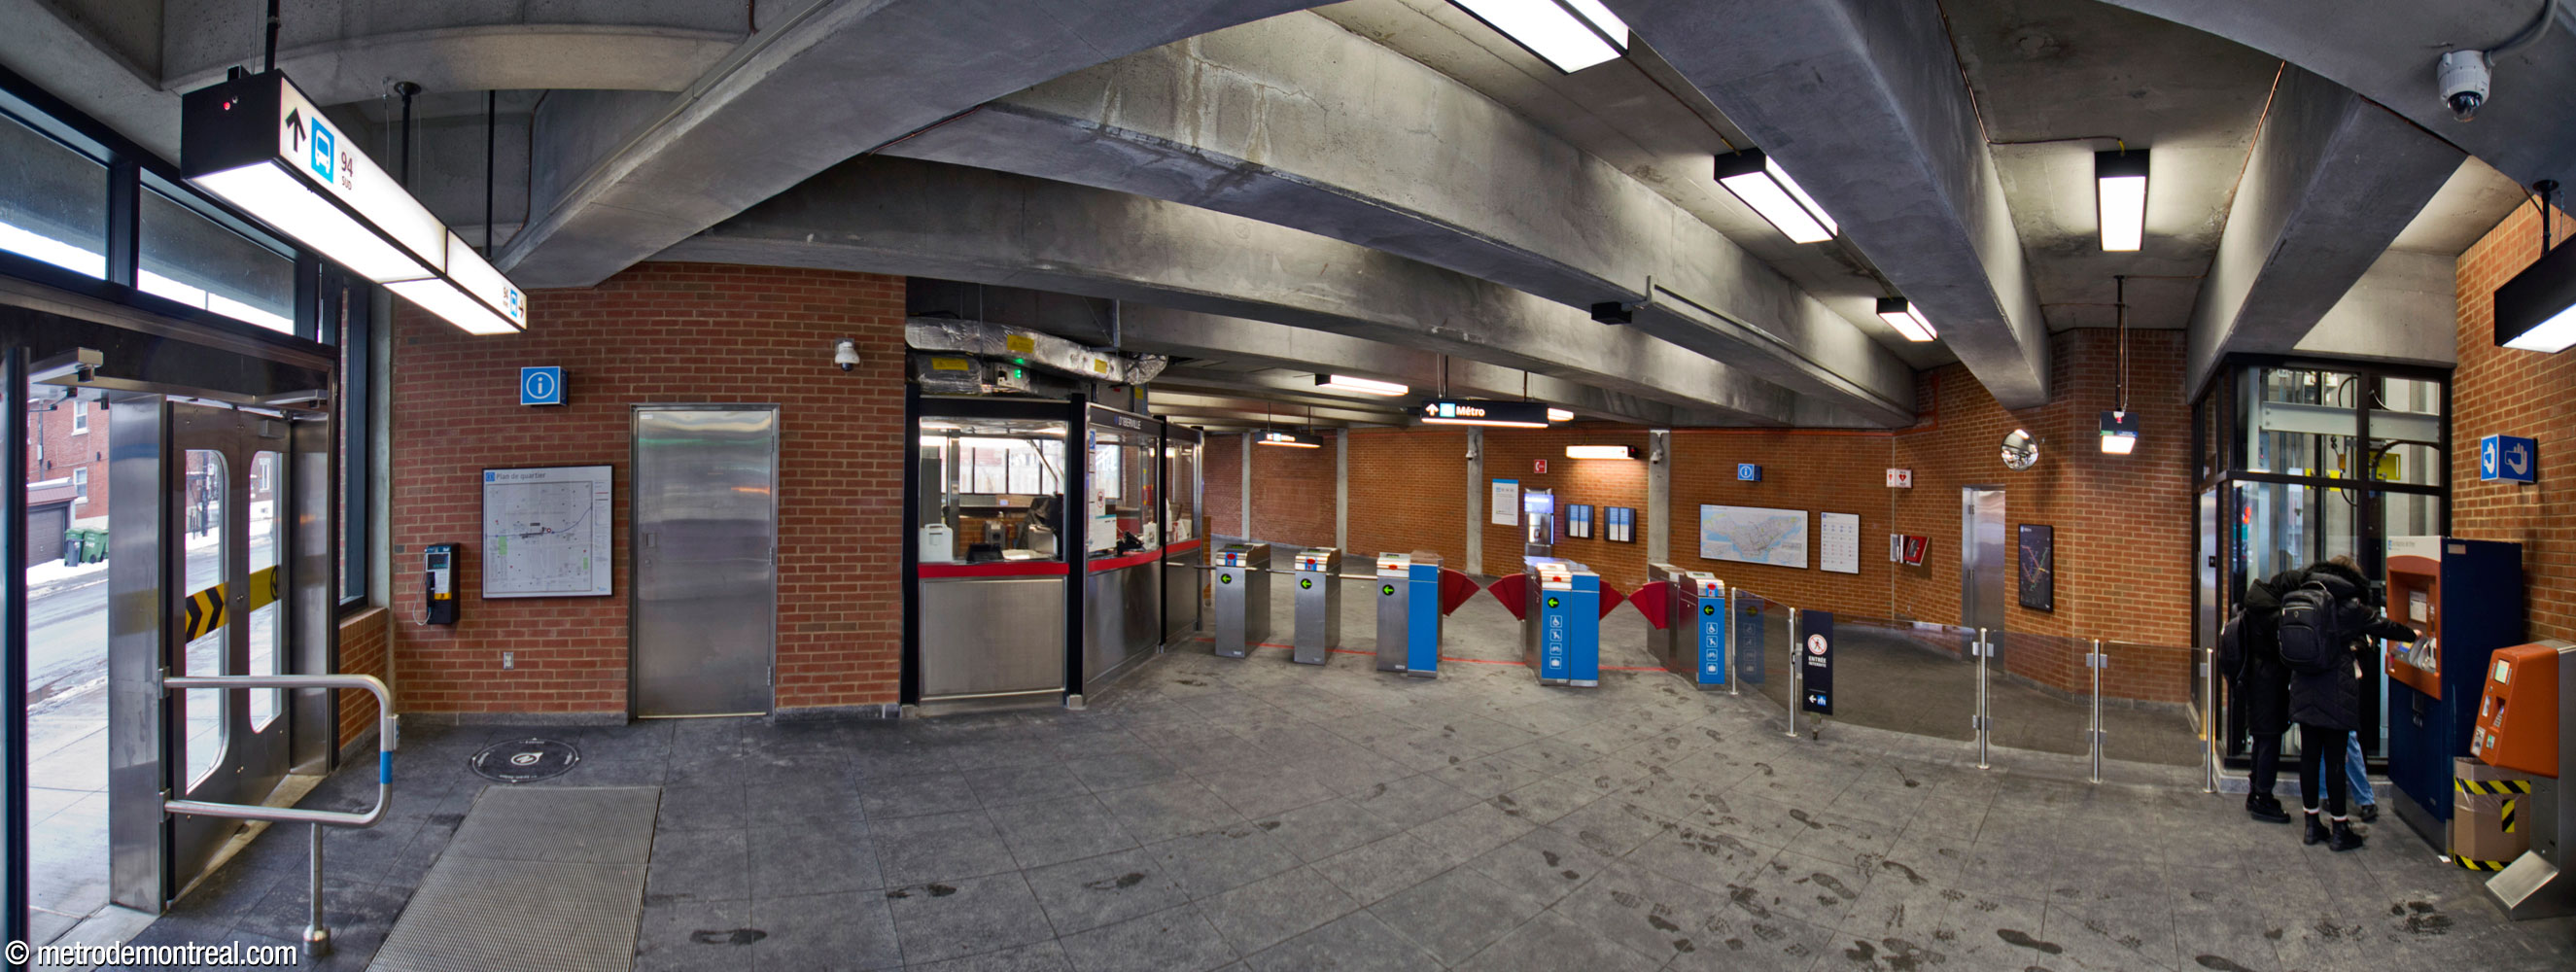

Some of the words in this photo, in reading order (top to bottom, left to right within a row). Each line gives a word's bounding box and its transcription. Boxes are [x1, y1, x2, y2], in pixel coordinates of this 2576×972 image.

[341, 151, 353, 177] 94
[342, 176, 352, 191] SUD
[1456, 405, 1485, 418] Métro
